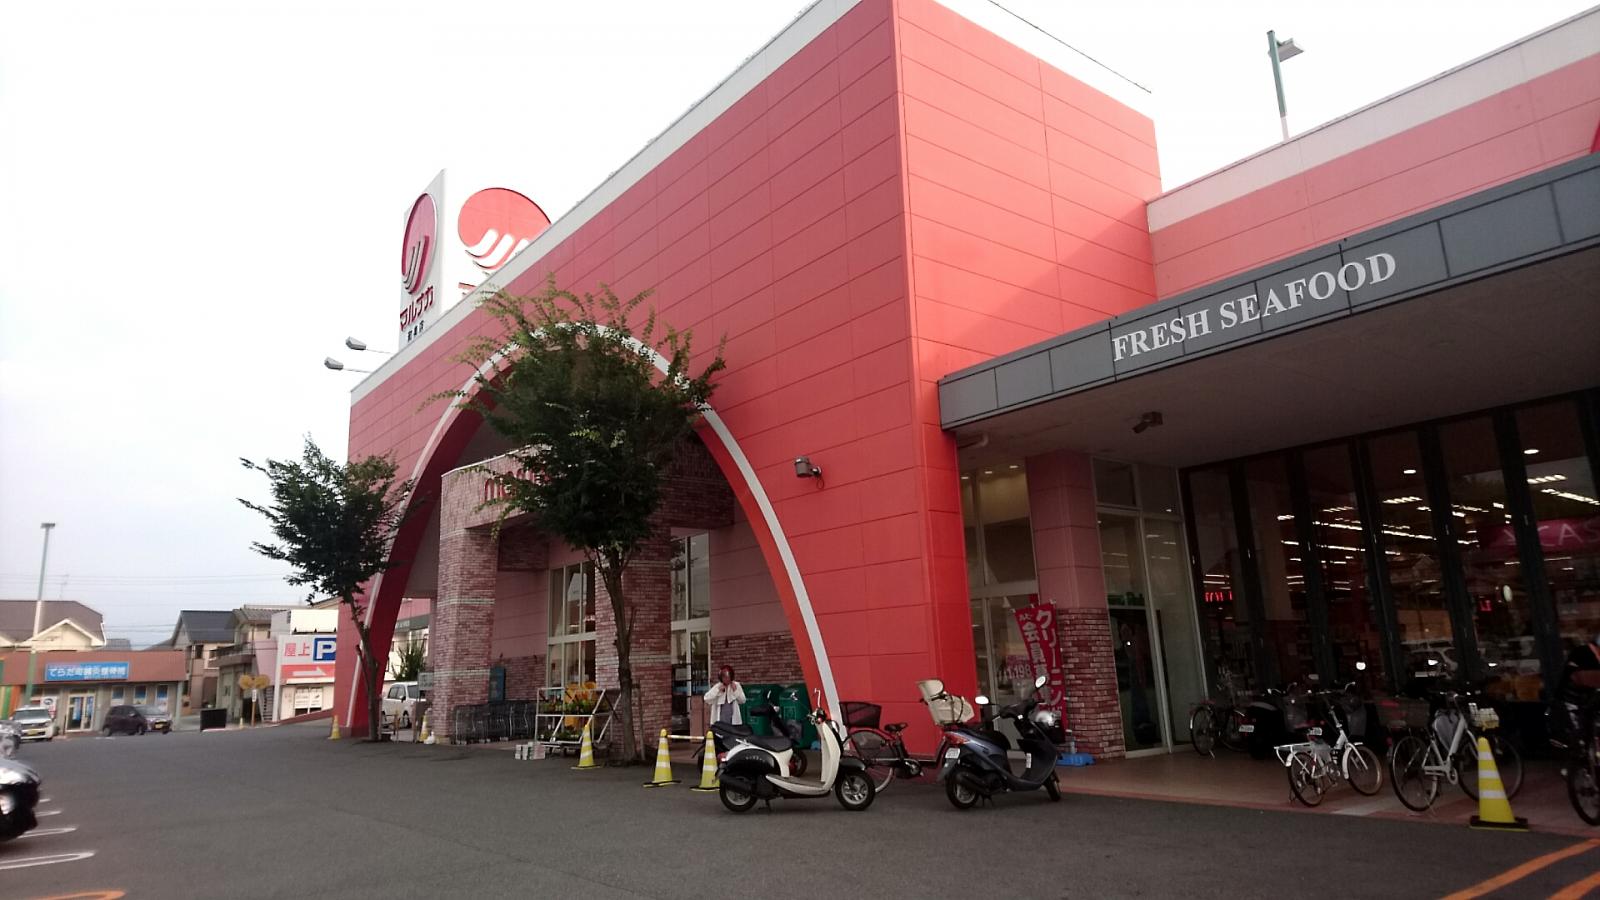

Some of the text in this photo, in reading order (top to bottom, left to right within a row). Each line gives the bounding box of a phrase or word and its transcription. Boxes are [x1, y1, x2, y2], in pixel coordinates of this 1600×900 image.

[1112, 252, 1397, 362] FRESH SEAFOOD
[316, 640, 336, 659] P
